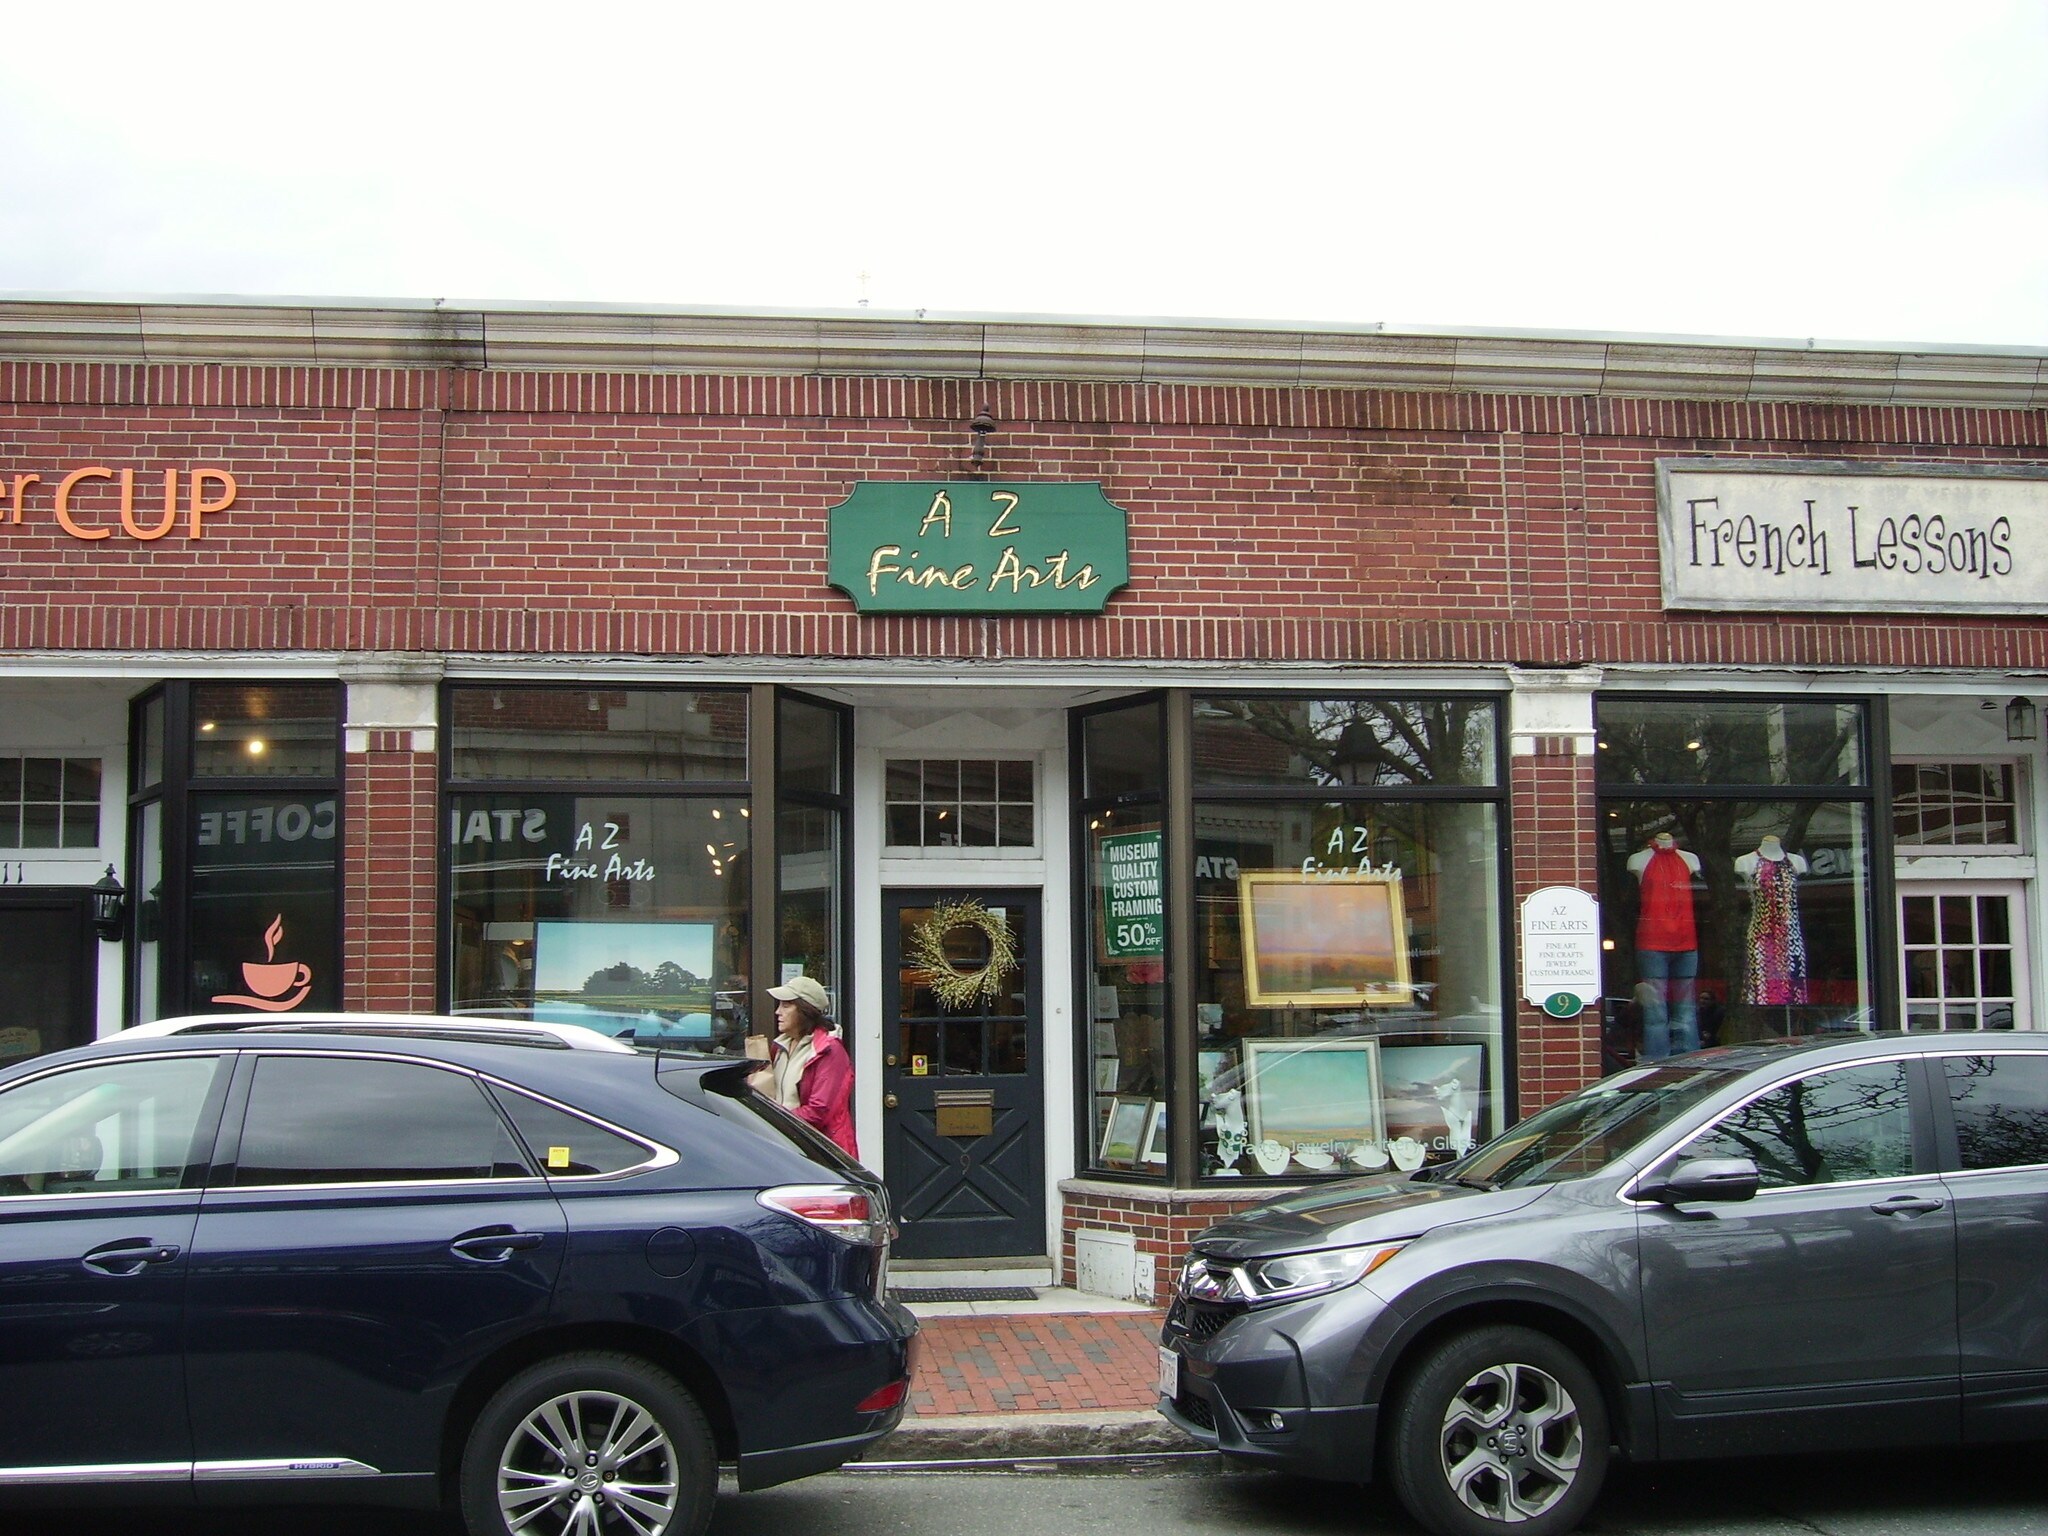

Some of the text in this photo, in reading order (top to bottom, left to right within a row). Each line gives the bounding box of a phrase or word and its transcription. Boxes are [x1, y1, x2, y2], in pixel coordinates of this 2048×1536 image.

[0, 466, 237, 540] r CUP
[918, 489, 1021, 538] A Z
[1687, 496, 2013, 580] French Lessons
[866, 544, 1101, 597] Fine Arts
[575, 822, 620, 851] A Z
[1327, 826, 1369, 855] A Z
[1109, 842, 1159, 862] MUSEUM
[3, 862, 23, 884] 11
[545, 852, 655, 882] Fine Arts
[1111, 861, 1158, 881] QUALITY
[1301, 855, 1403, 883] Fine Arts
[1961, 860, 1969, 874] 7
[1112, 880, 1159, 899] CUSTOM
[1111, 898, 1163, 917] FRAMING
[1551, 906, 1567, 916] AZ
[1116, 923, 1156, 947] 50%
[1531, 920, 1588, 930] FINE ARTS
[1144, 936, 1162, 946] OFF
[1545, 942, 1577, 950] FINE ART
[1539, 951, 1584, 959] FINE CRAFTS
[1529, 969, 1594, 977] CUSTOM FRAMING
[1557, 994, 1569, 1014] 9
[1289, 1138, 1350, 1160] Jewelry
